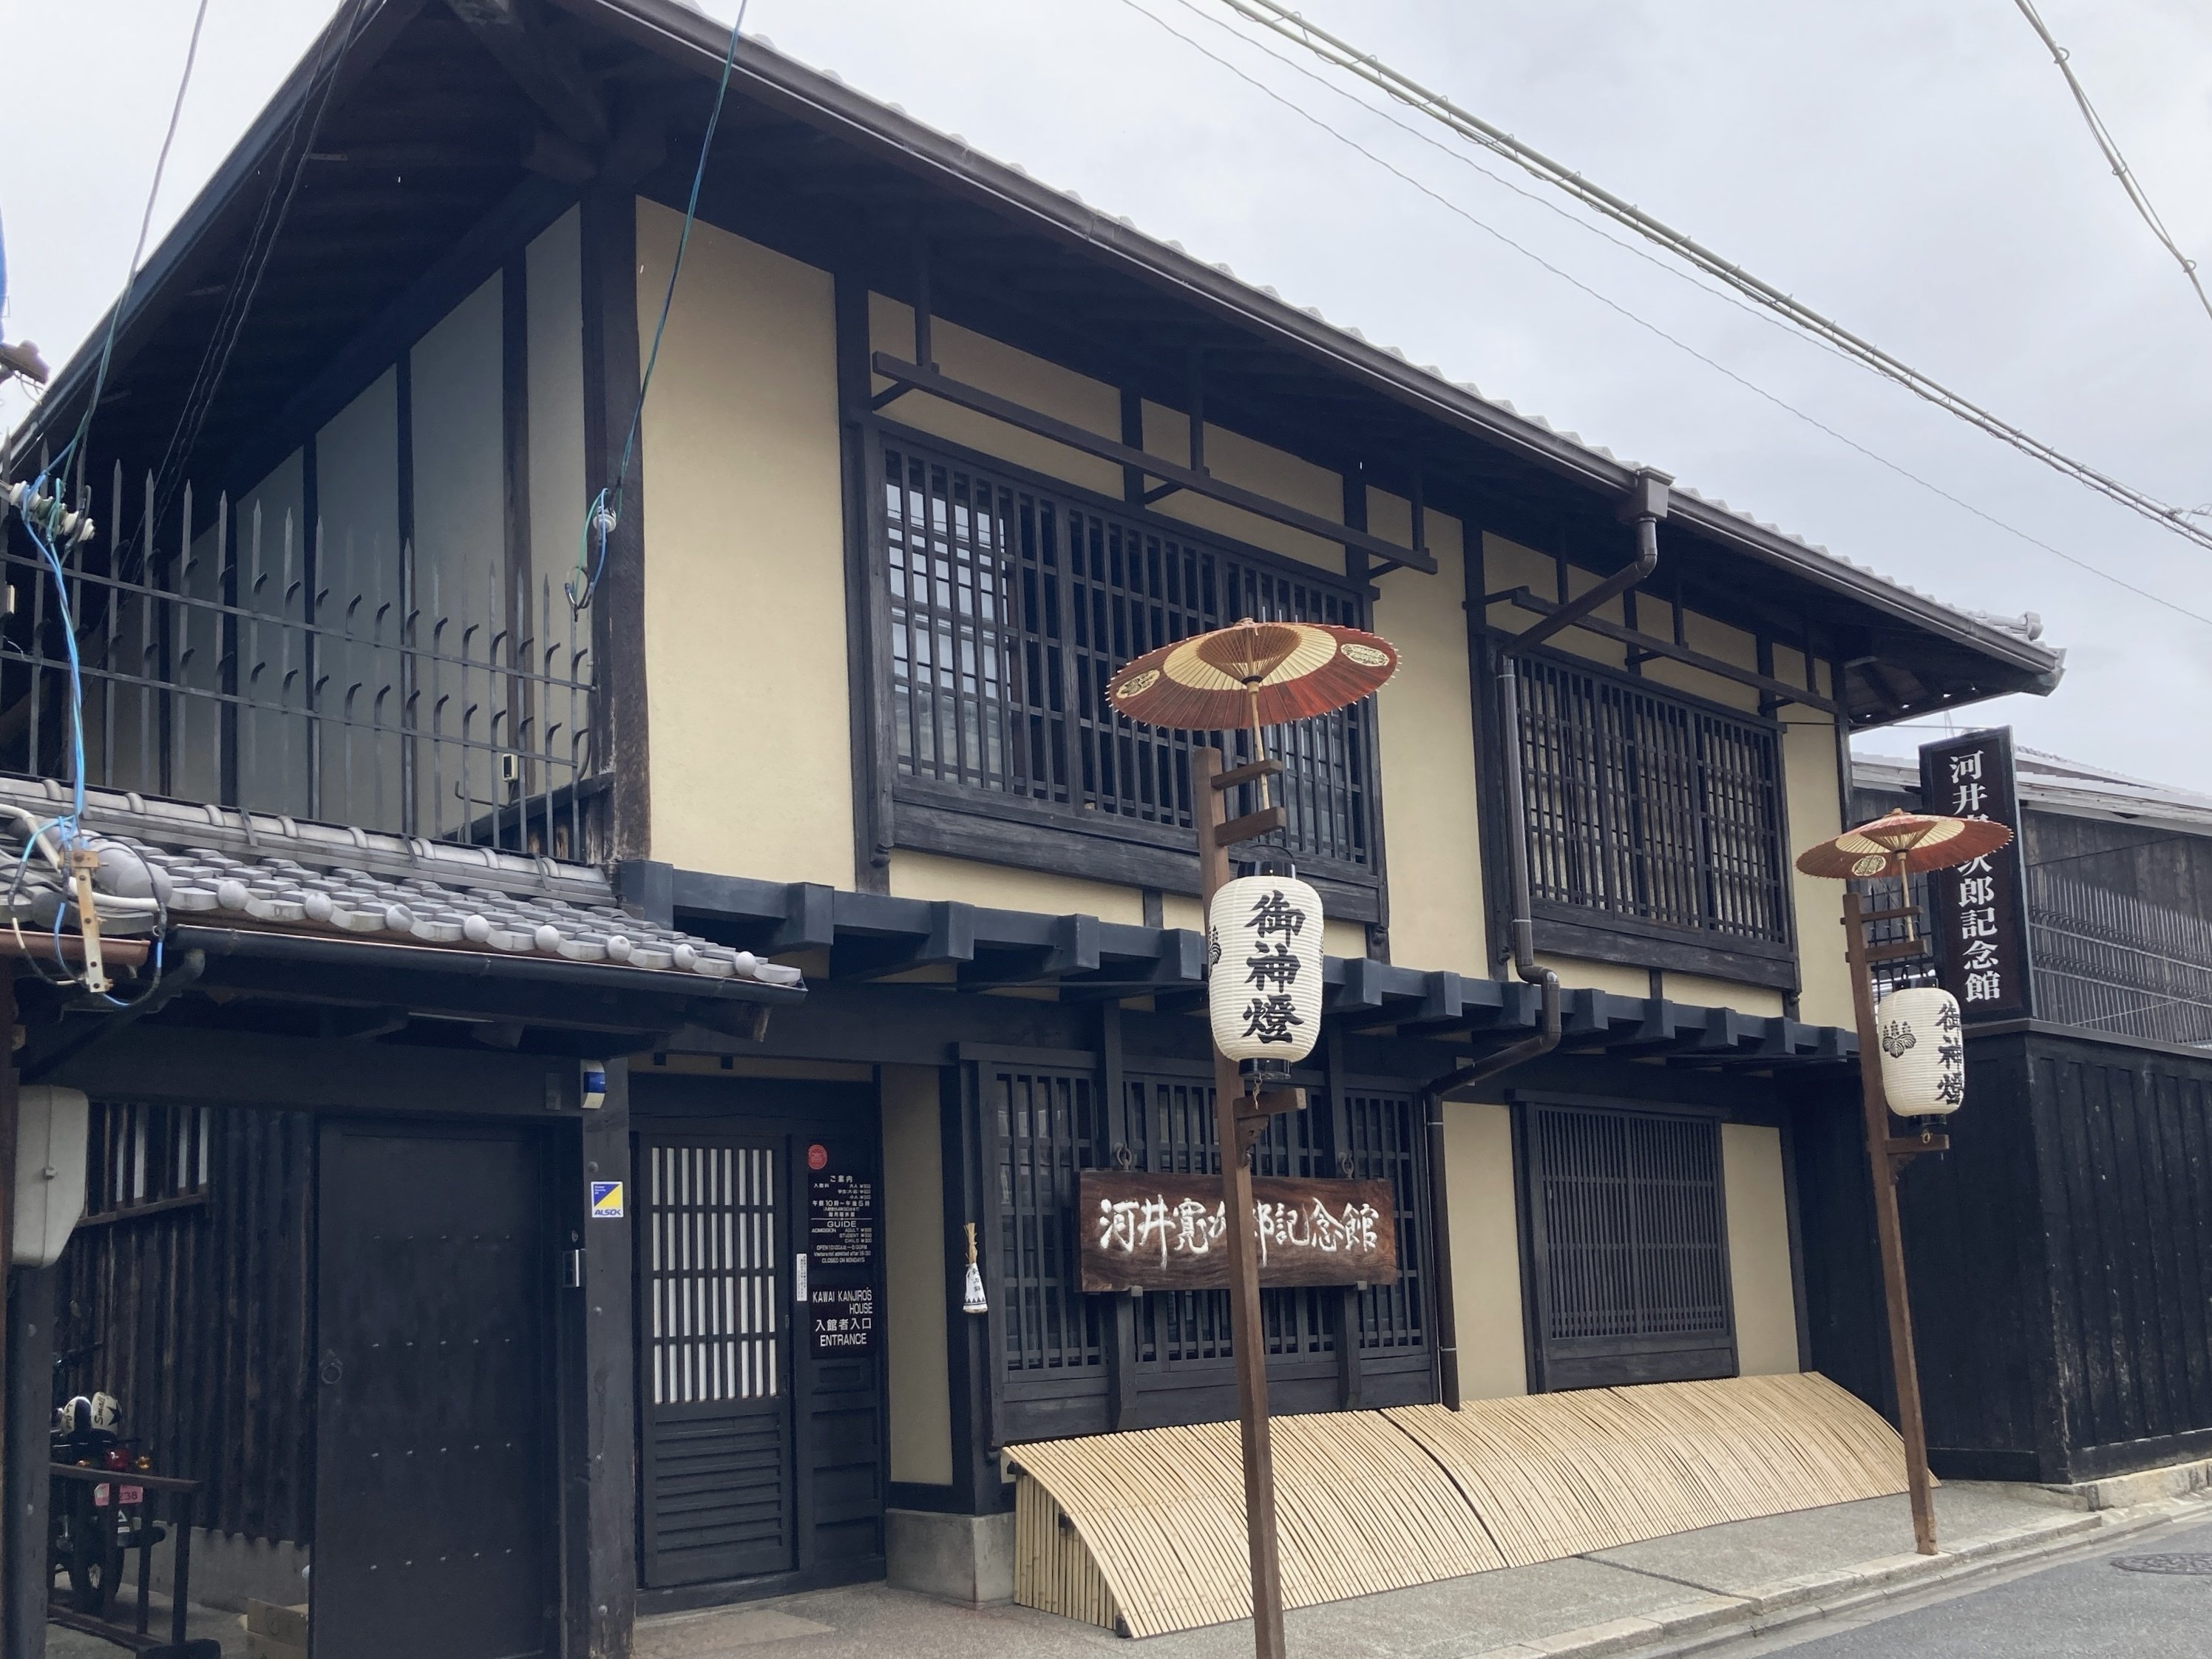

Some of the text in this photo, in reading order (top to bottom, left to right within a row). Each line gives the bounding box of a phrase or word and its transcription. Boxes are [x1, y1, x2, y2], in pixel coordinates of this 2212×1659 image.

[1241, 889, 1306, 1043] 御神燈
[830, 1175, 853, 1183] ご案内
[812, 1291, 835, 1303] KAWAI
[849, 1303, 872, 1314] HOUSE
[815, 1317, 871, 1331] 入館者入口
[820, 1333, 866, 1346] ENTRANCE
